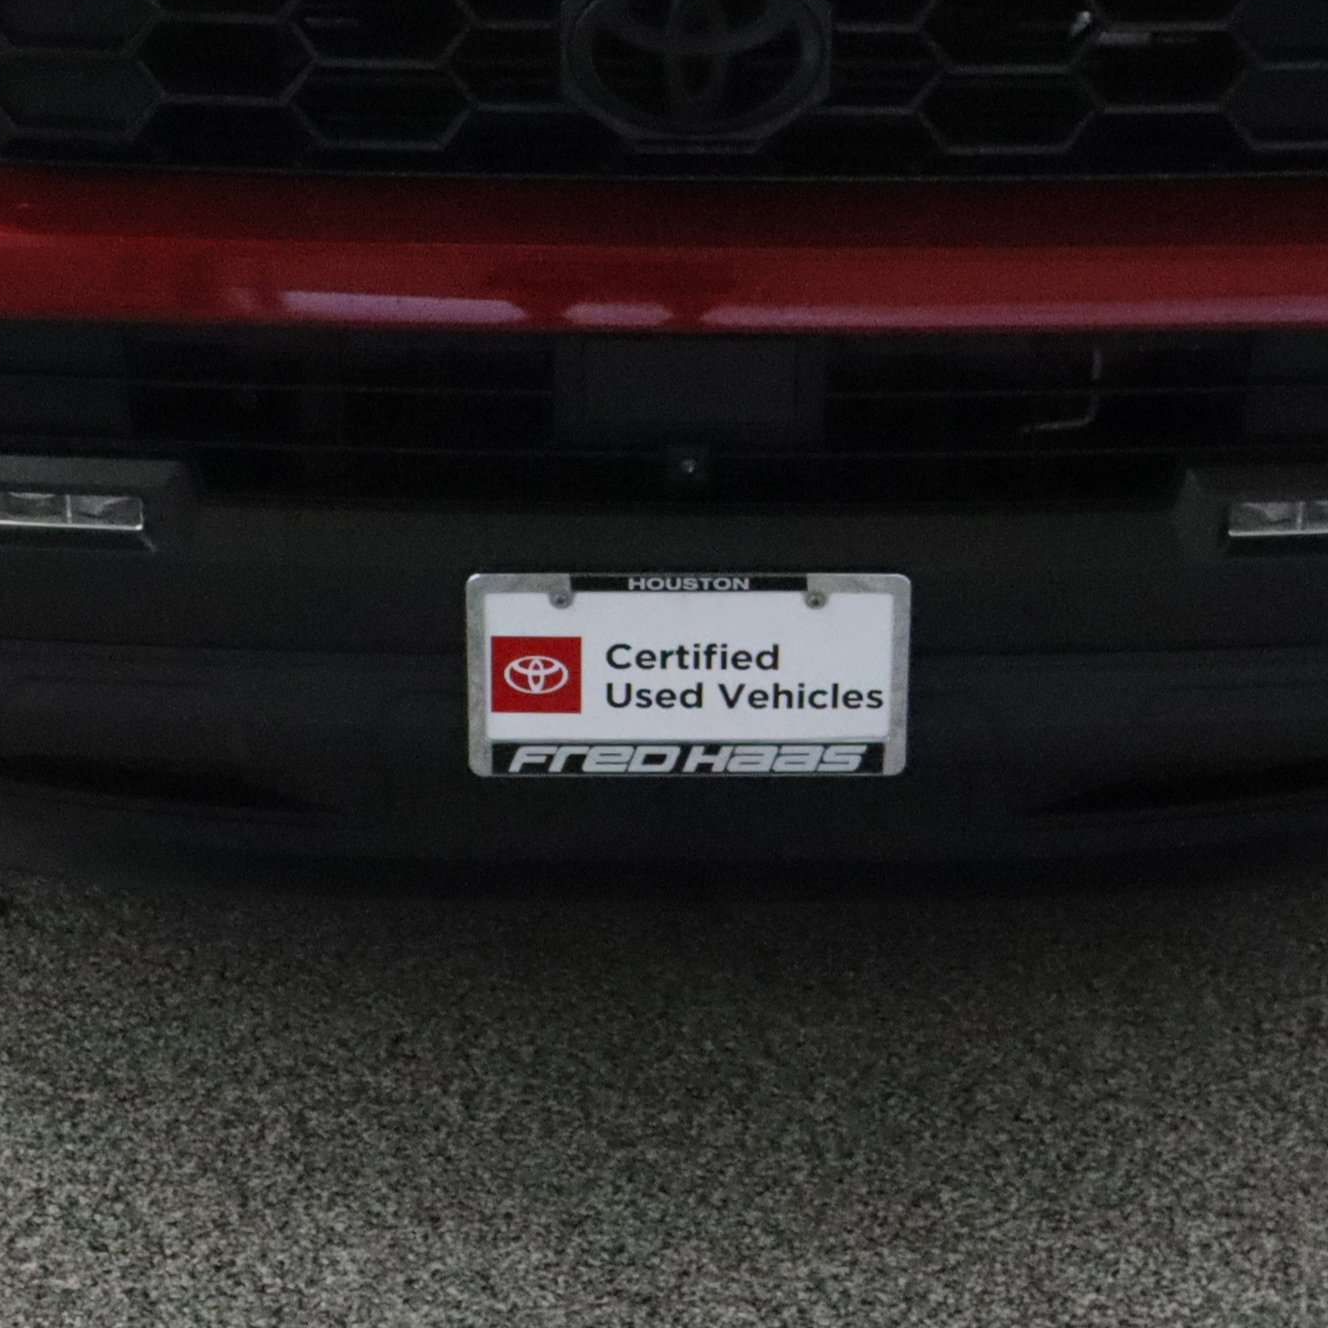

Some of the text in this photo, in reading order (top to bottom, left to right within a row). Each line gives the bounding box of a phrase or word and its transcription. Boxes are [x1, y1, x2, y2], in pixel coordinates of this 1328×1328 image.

[628, 578, 750, 591] HOUSTON
[605, 643, 780, 671] Certified
[605, 682, 884, 710] Used Vehicles
